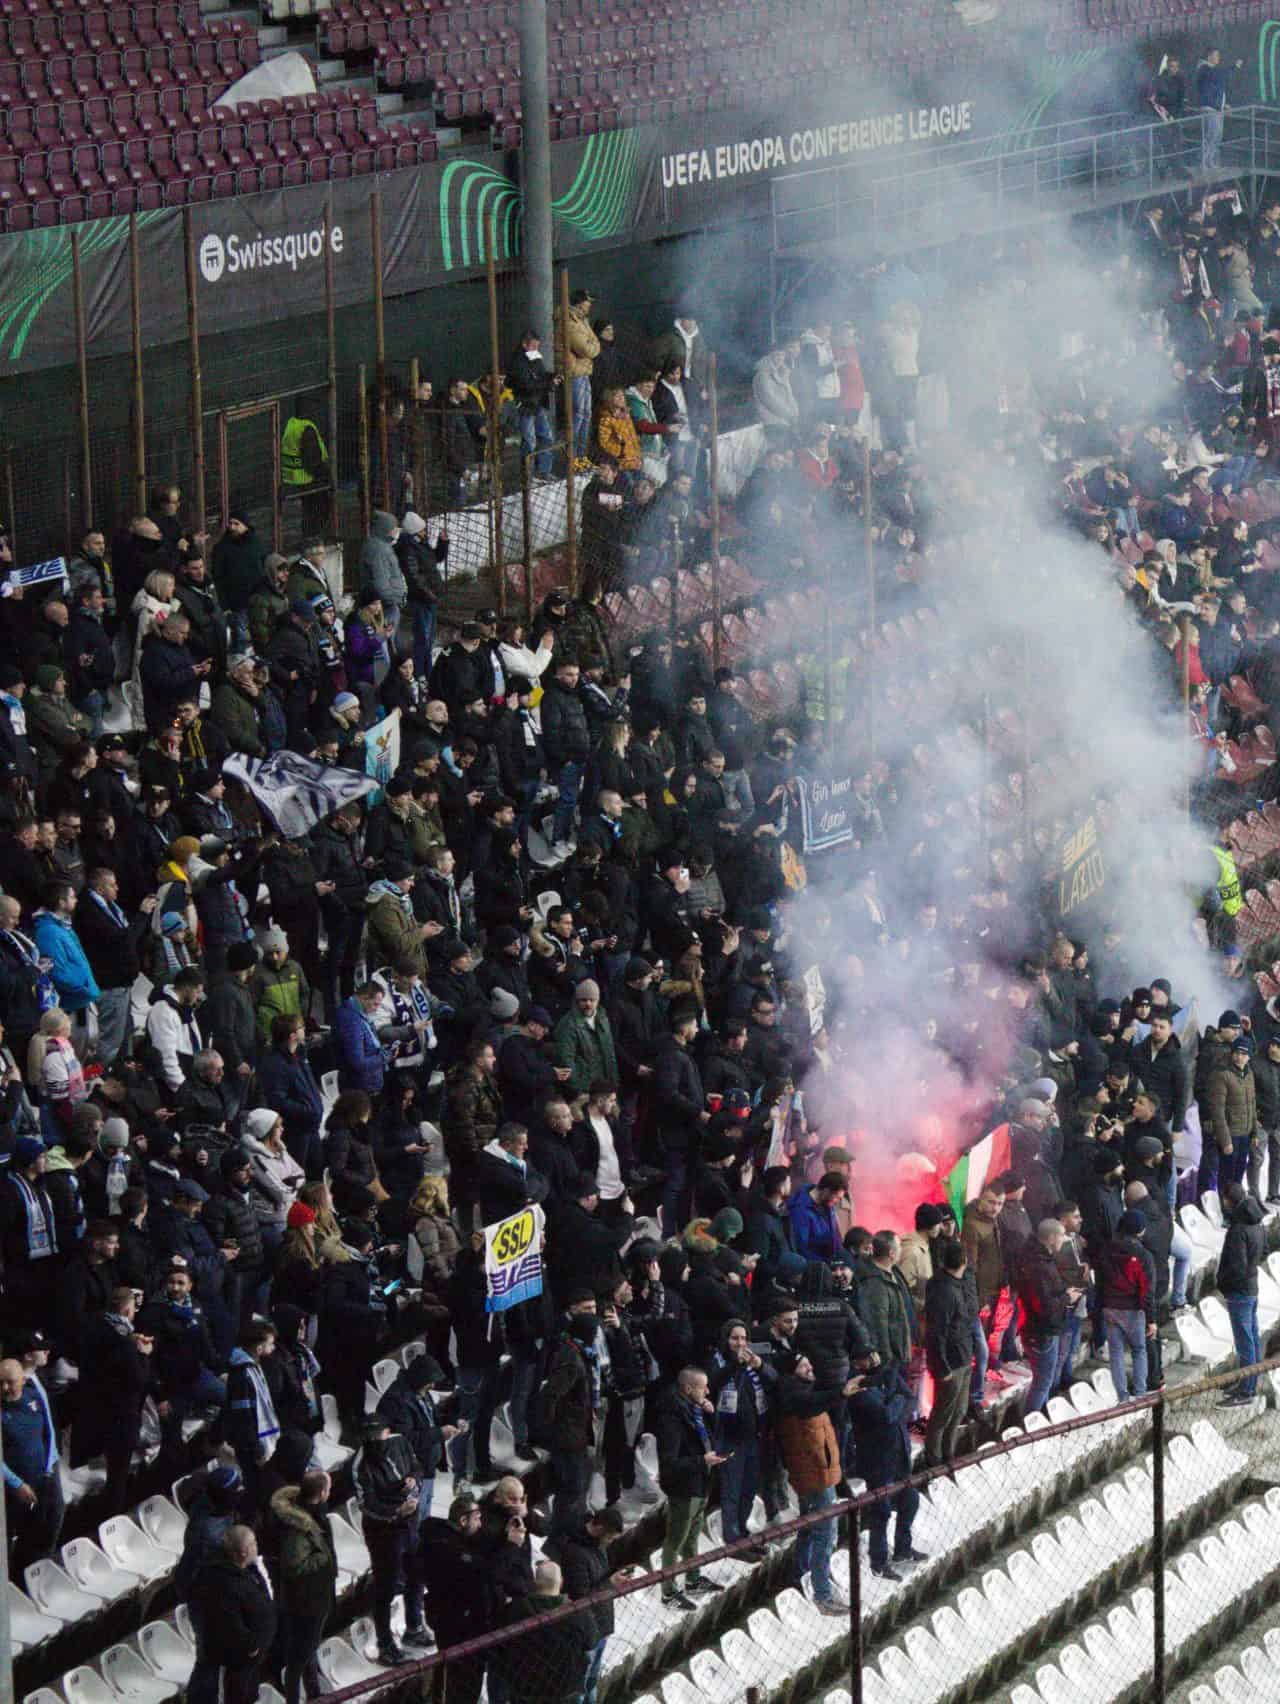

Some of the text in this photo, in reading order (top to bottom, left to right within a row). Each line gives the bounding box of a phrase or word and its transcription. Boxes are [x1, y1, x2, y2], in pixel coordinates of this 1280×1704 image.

[662, 102, 972, 188] UEFA EUROPA CONFERENCE LEAGUE
